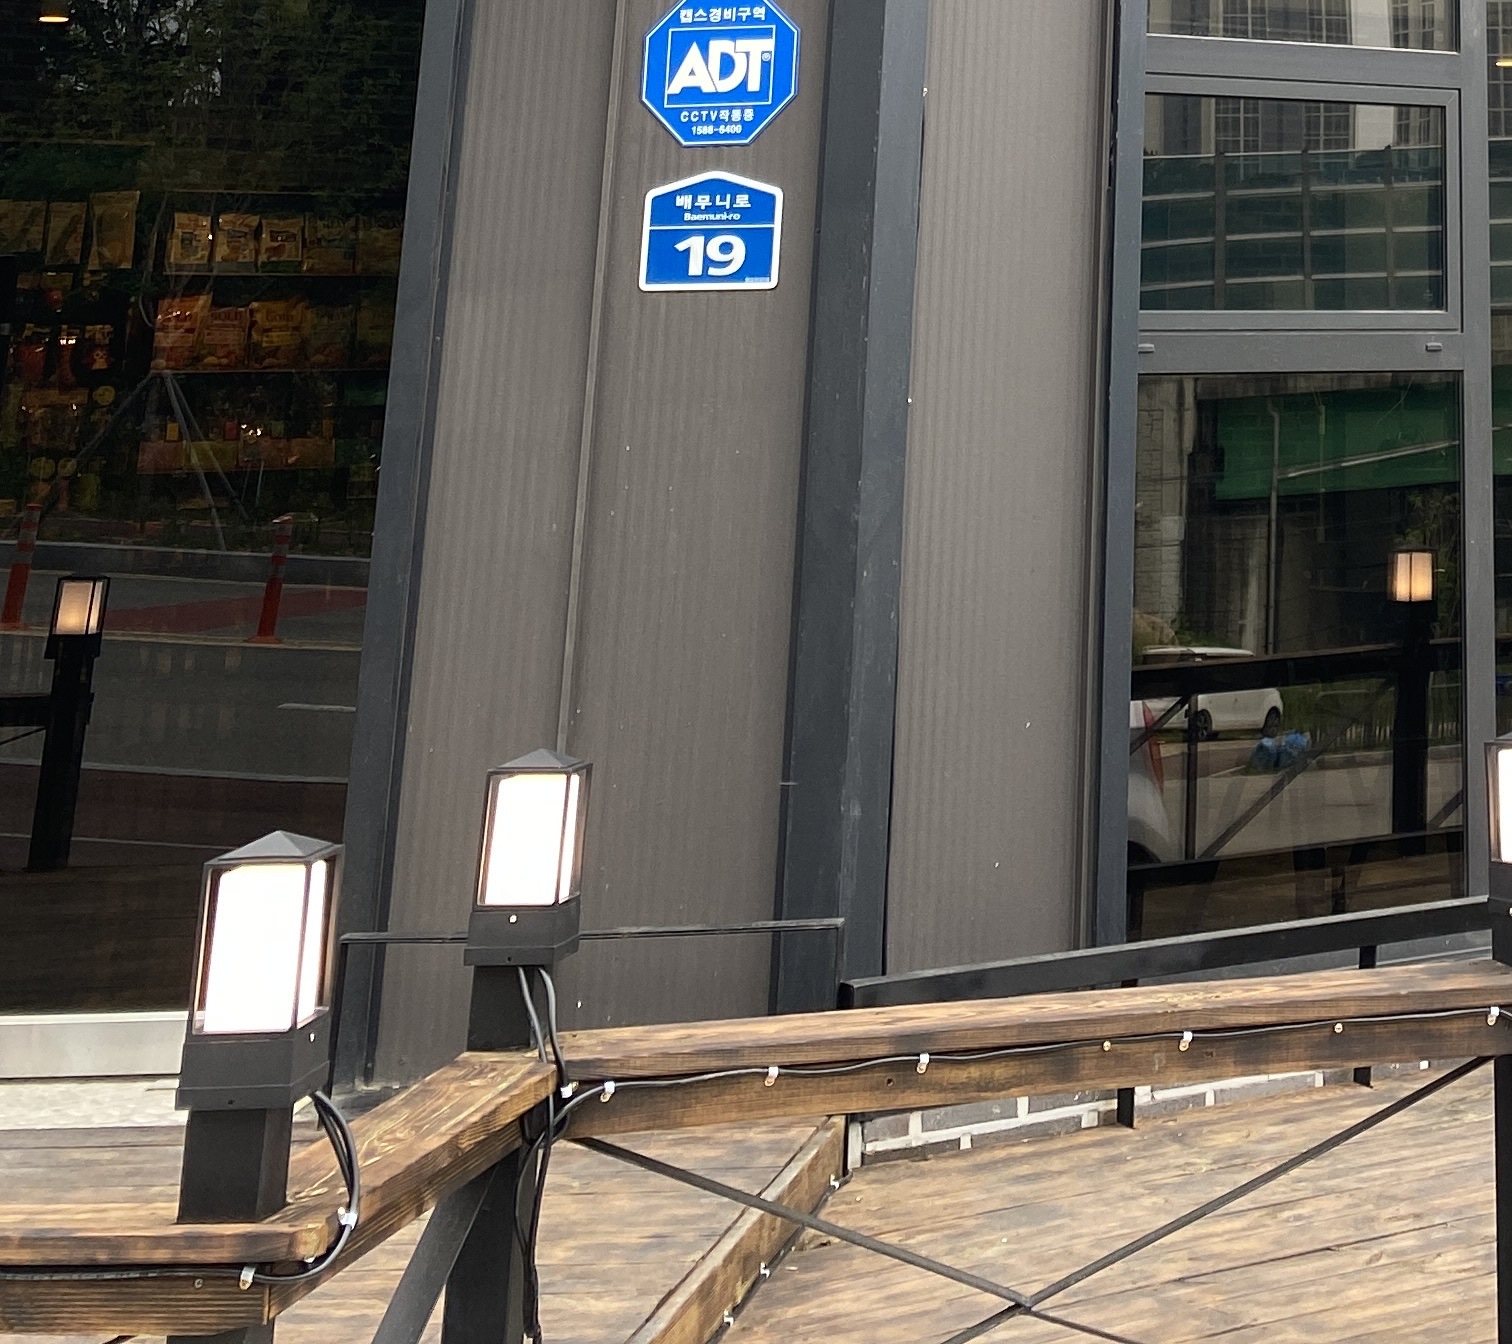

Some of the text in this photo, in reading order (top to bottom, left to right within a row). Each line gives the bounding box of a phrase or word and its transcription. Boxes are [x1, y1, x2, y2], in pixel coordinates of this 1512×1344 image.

[666, 38, 774, 96] ADT
[690, 123, 743, 136] 1588-6400
[674, 193, 752, 211] 배무니로
[683, 211, 742, 223] Baemuni-ro
[673, 234, 747, 277] 19
